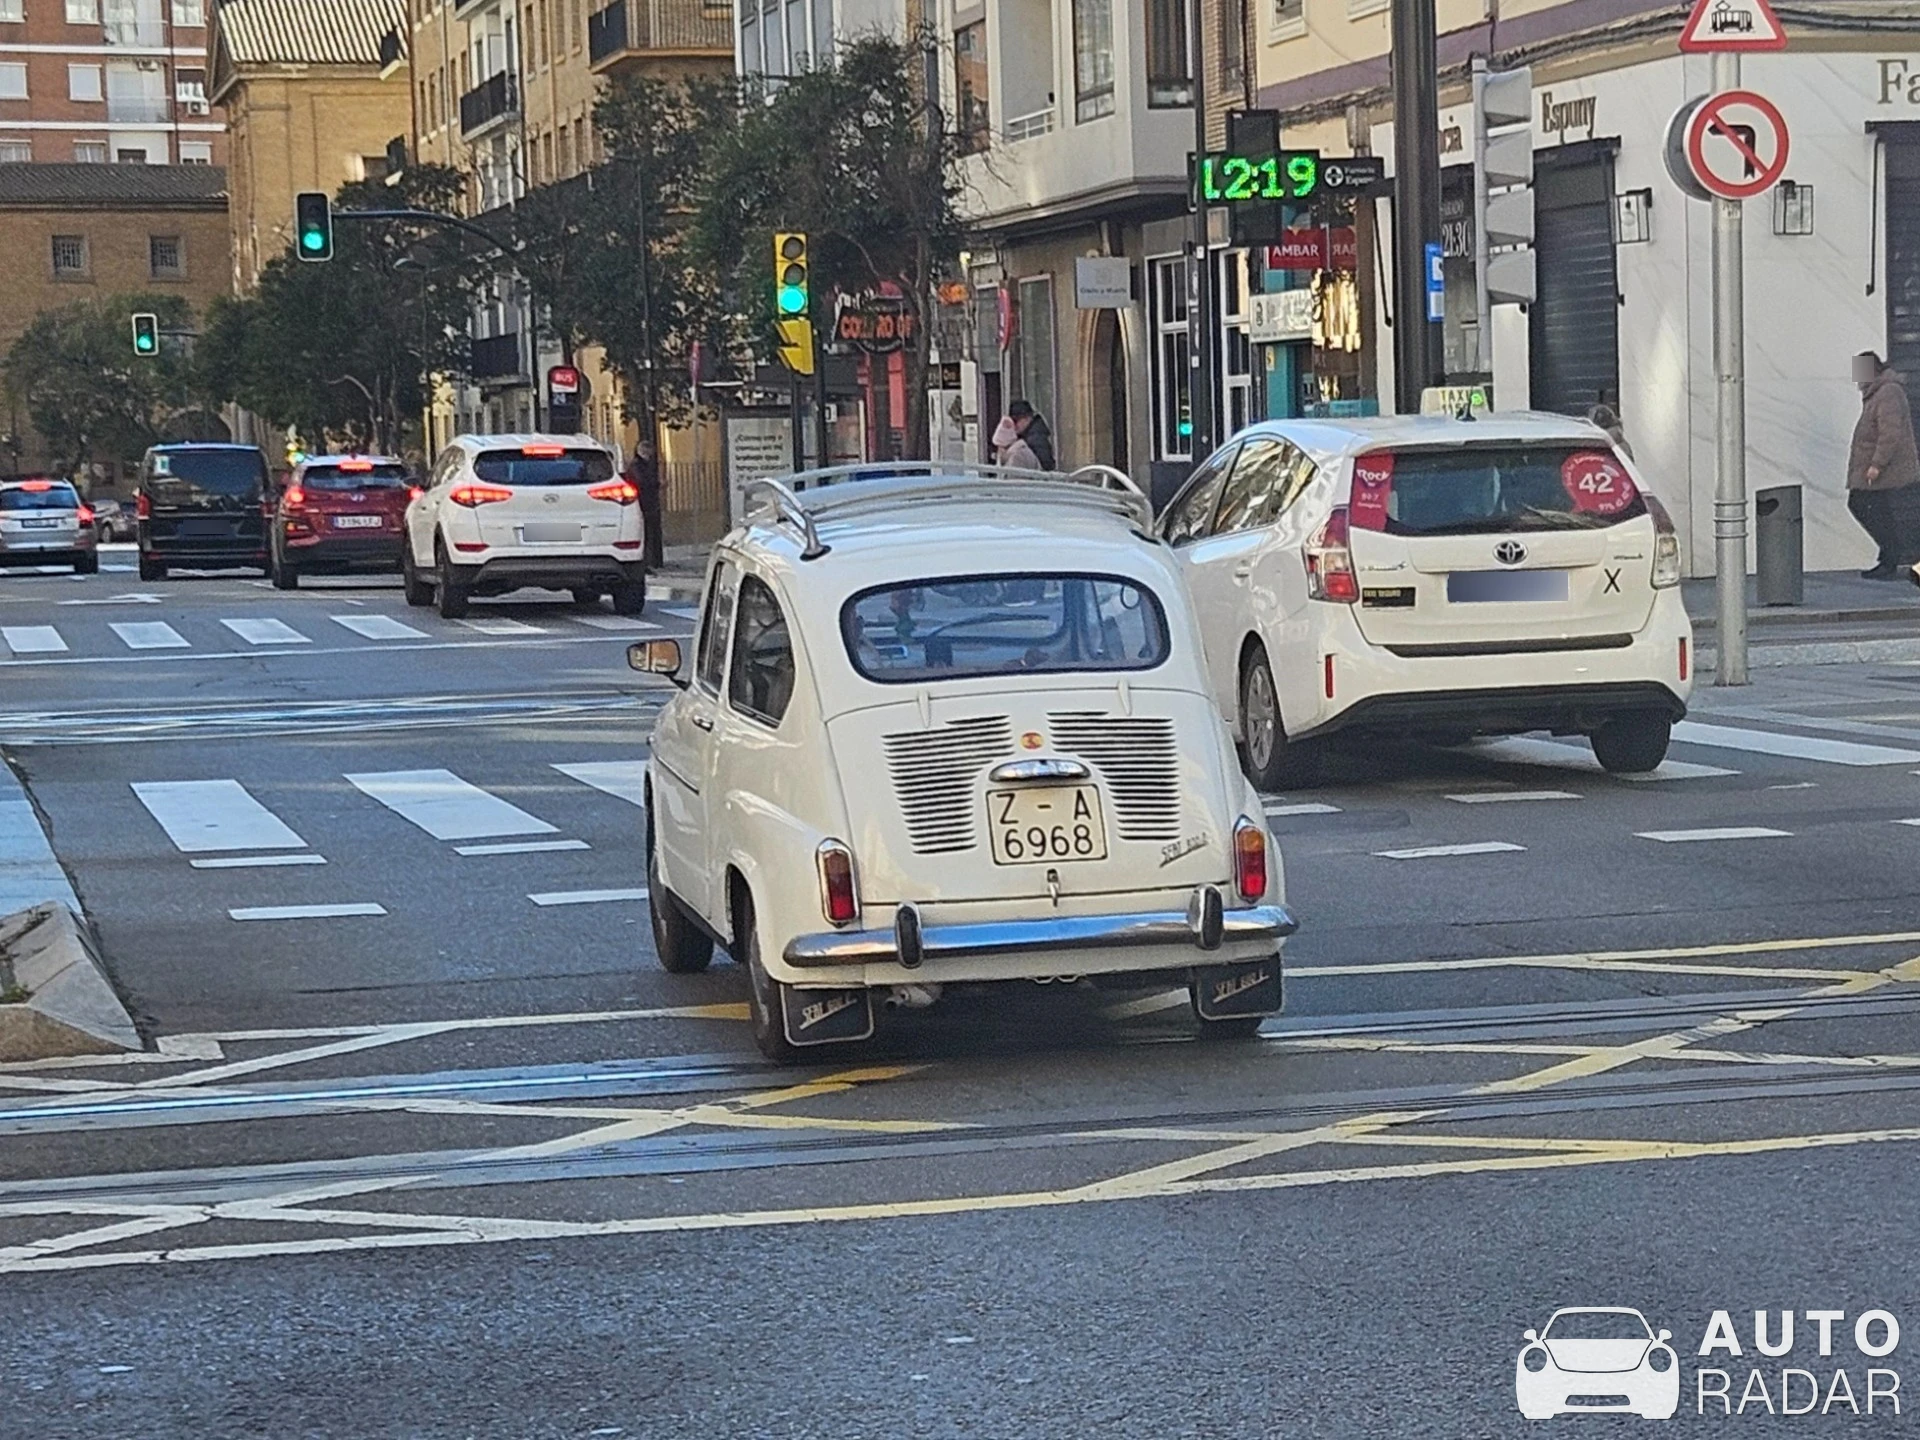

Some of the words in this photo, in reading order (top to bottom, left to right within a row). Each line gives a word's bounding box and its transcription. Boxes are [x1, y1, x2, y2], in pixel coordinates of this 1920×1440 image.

[1542, 91, 1597, 145] Espuny
[1272, 243, 1320, 257] AMBAR
[555, 372, 575, 382] BUS
[1441, 389, 1470, 401] TAXI
[1578, 472, 1615, 494] 42
[1603, 567, 1622, 594] X
[996, 792, 1020, 825] Z
[1073, 788, 1092, 820] A
[1004, 823, 1094, 859] 6968
